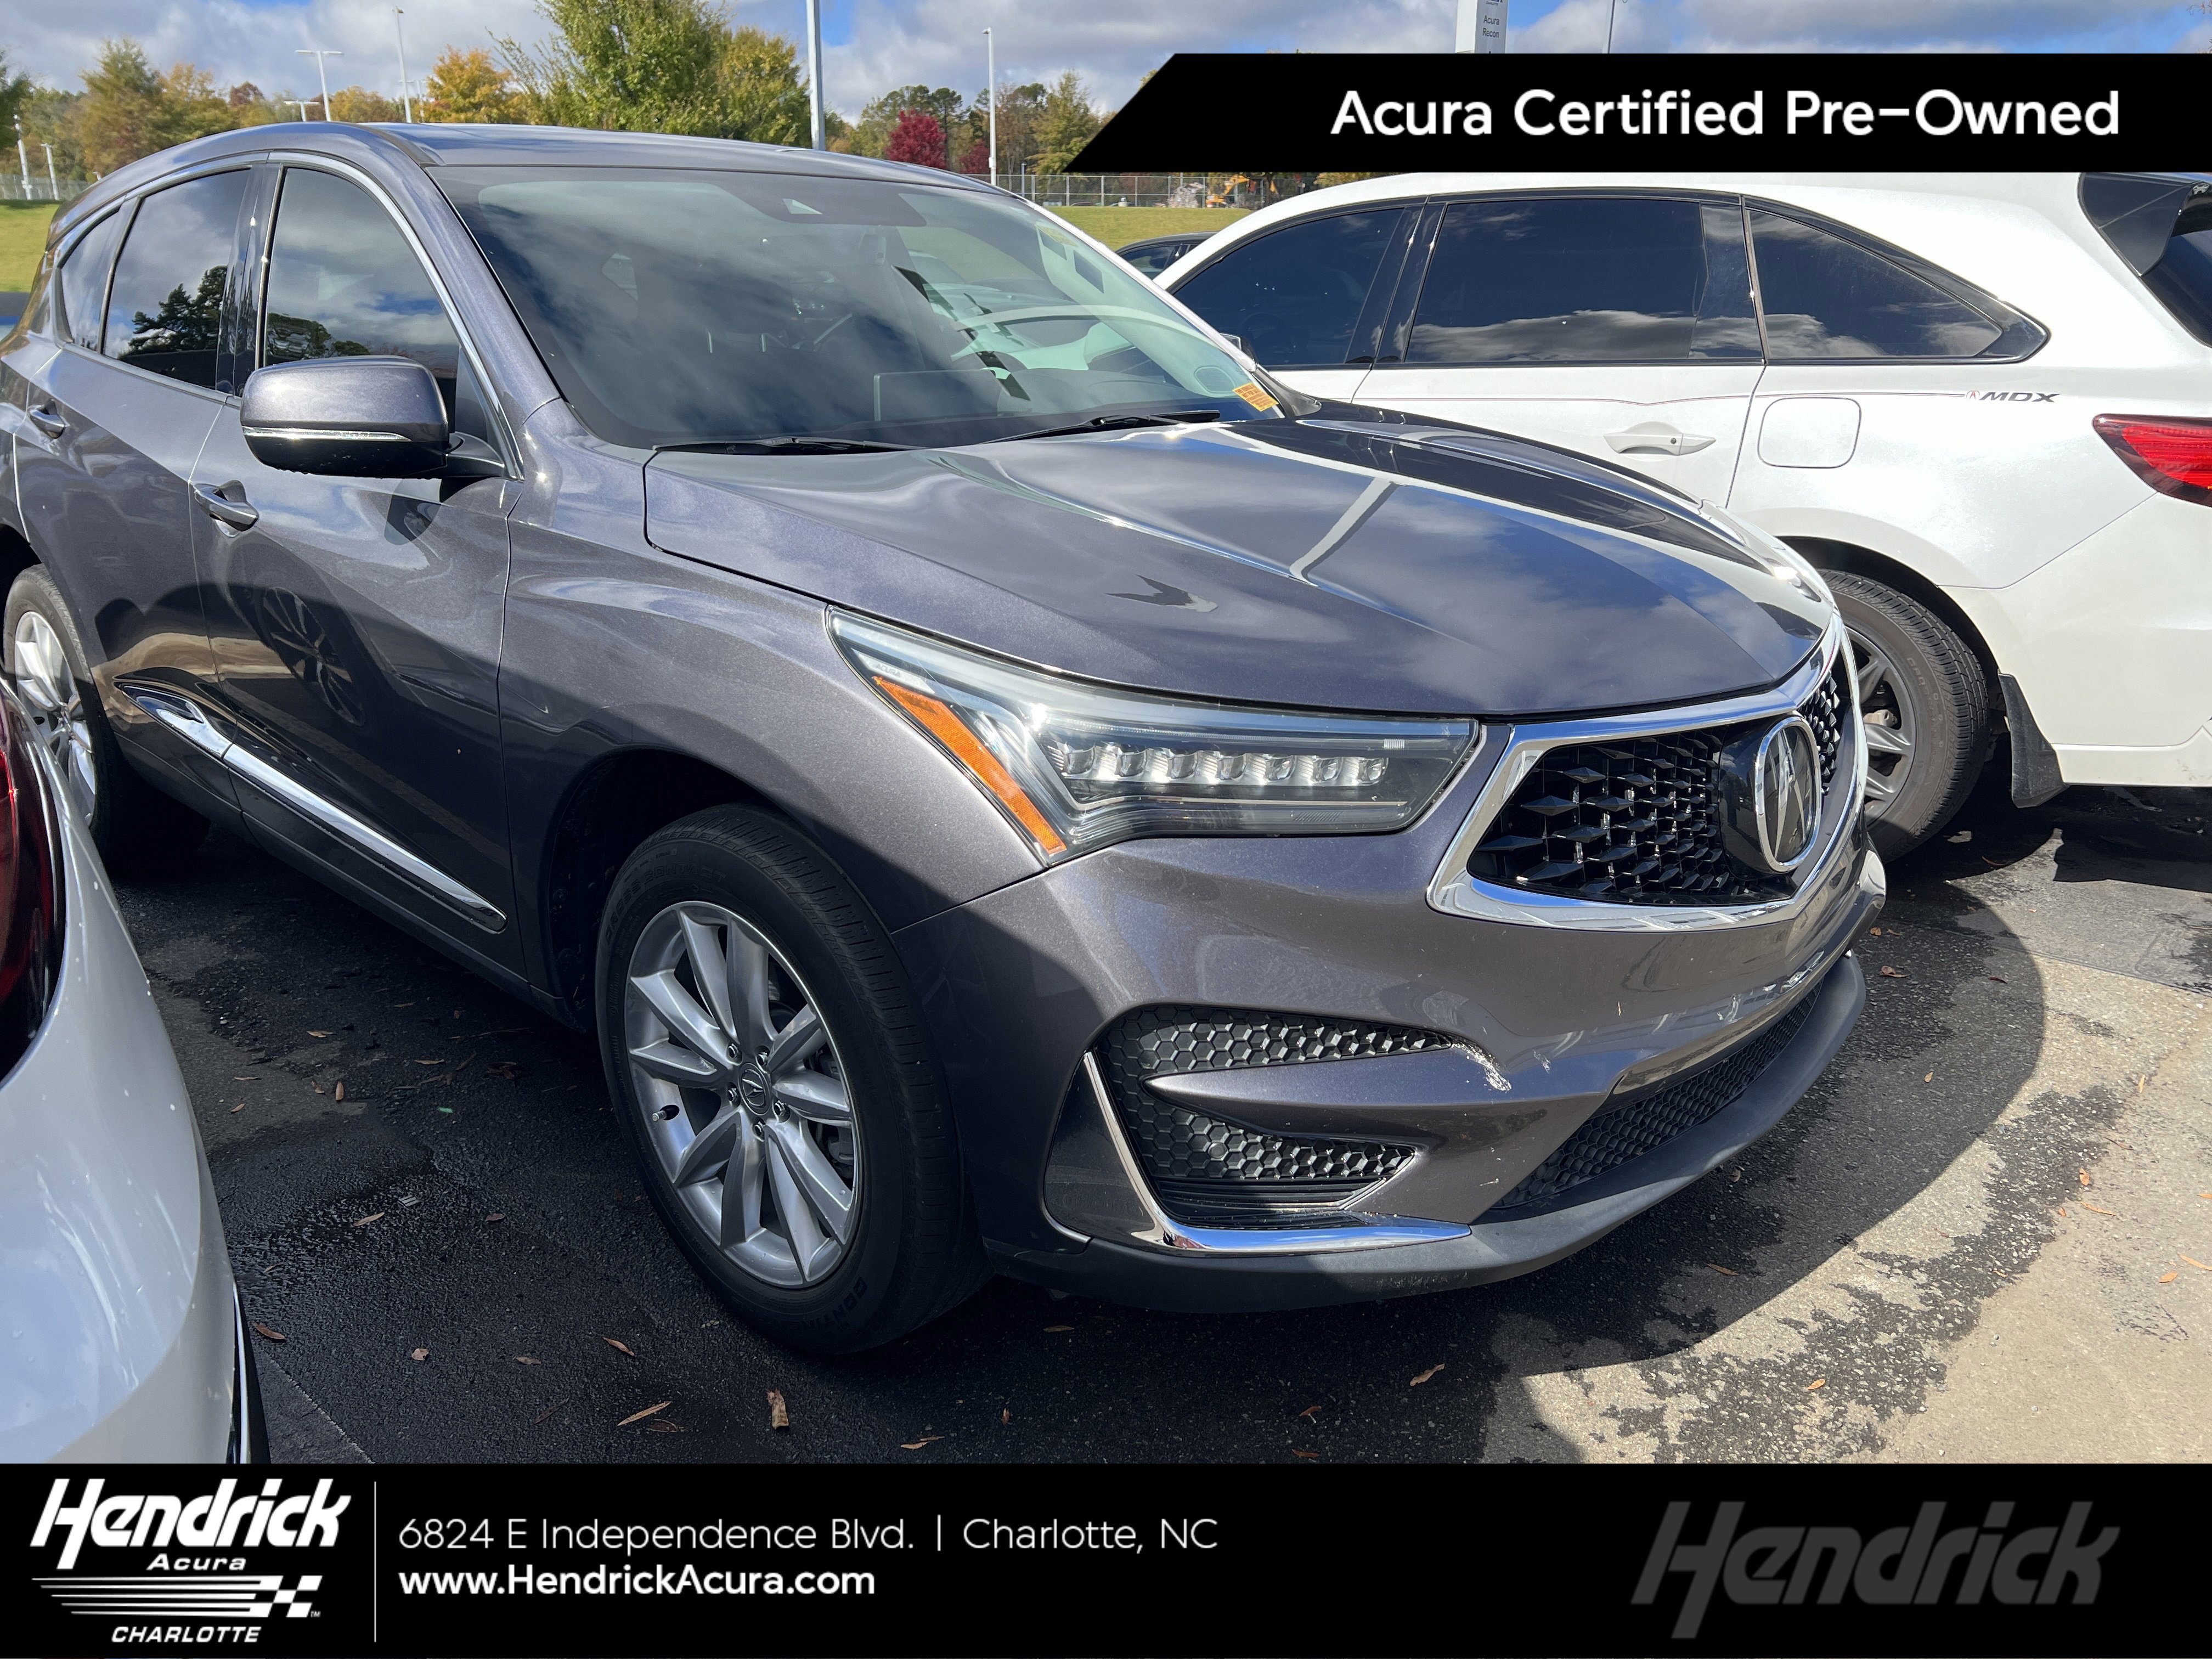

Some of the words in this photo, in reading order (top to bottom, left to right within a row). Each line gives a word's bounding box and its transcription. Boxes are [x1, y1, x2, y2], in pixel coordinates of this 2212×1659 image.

[1483, 15, 1500, 25] Acura
[1482, 27, 1499, 38] Recon
[1978, 391, 2061, 403] MDX
[876, 664, 901, 677] ACURA
